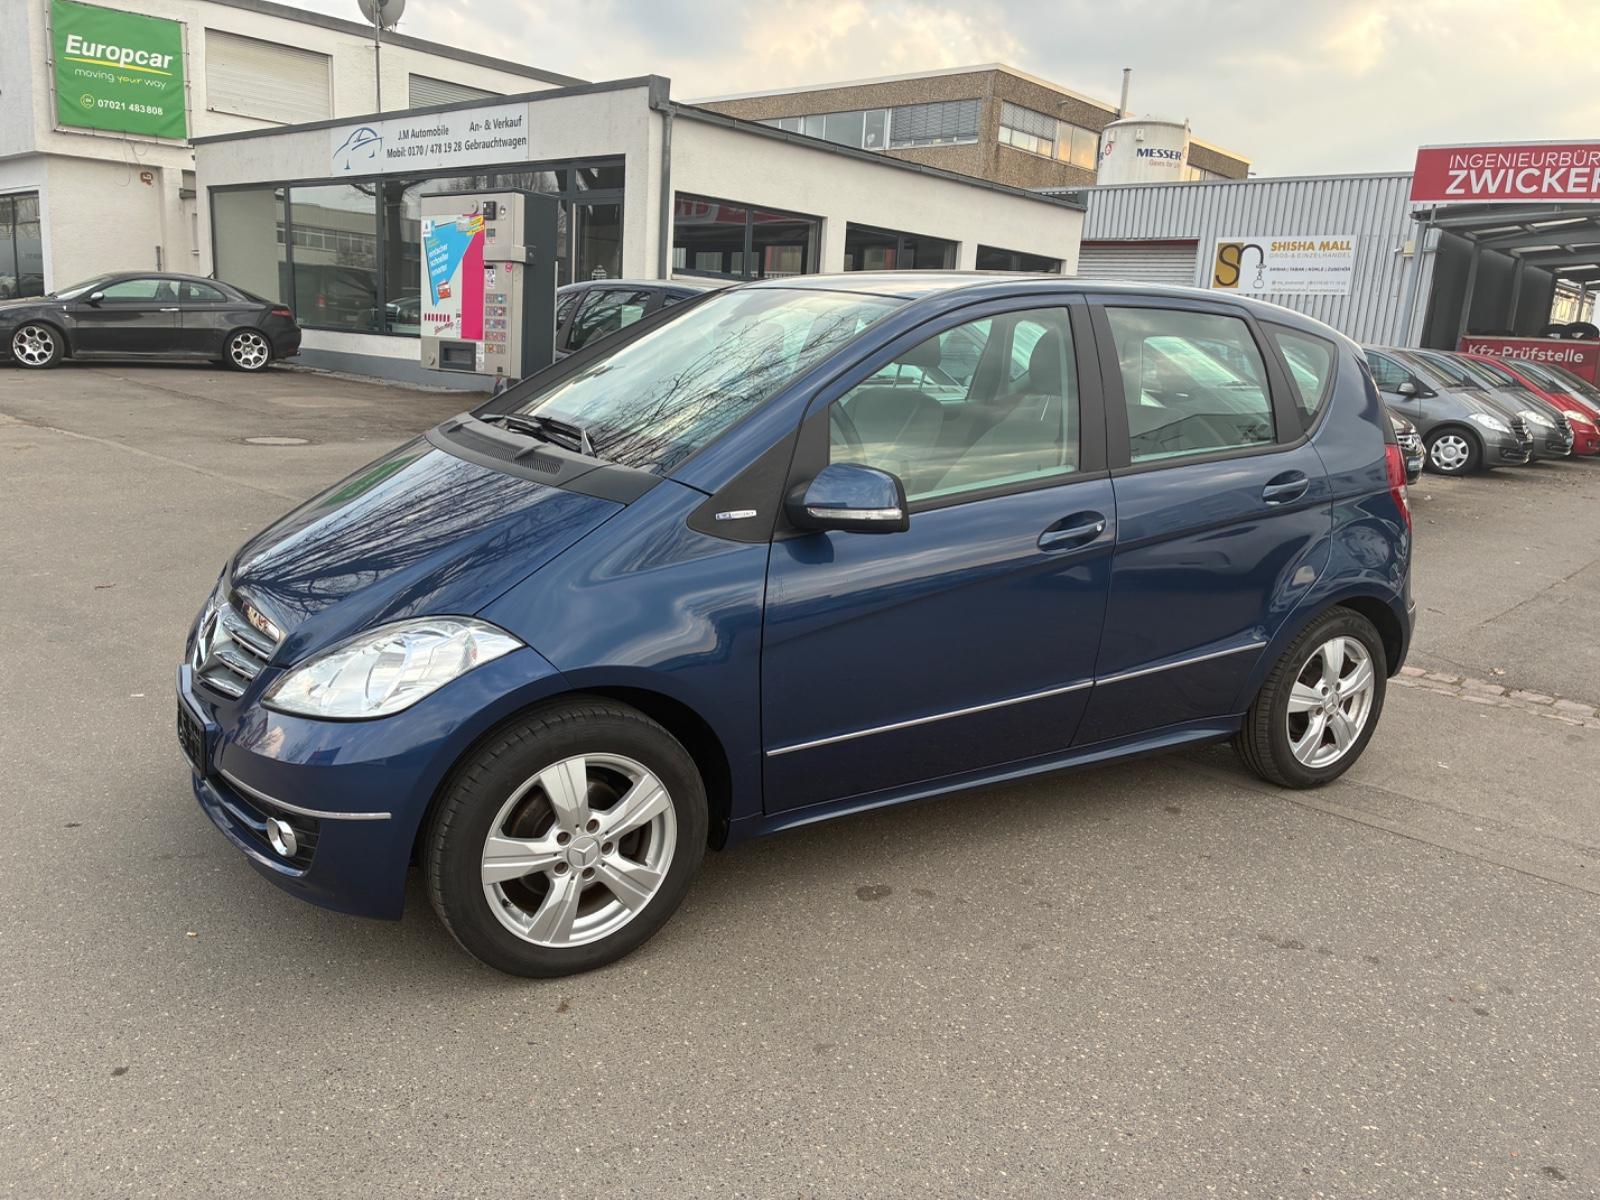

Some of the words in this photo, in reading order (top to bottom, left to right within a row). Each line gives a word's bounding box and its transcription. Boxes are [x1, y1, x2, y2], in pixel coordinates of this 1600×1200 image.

[65, 34, 173, 68] Europcar
[75, 69, 115, 82] moving
[117, 75, 142, 84] your
[144, 79, 167, 90] way
[97, 99, 126, 110] 07021
[469, 121, 482, 132] An-
[484, 119, 491, 130] &
[493, 115, 522, 129] Verkauf
[398, 129, 410, 140] J.M
[410, 124, 449, 139] Automobile
[408, 145, 424, 156] 0170
[425, 144, 429, 156] /
[430, 143, 442, 154] 478
[444, 142, 452, 153] 19
[454, 141, 462, 152] 28
[465, 136, 527, 150] Gebrauchtwagen
[1136, 148, 1182, 160] MESSER
[1271, 240, 1315, 252] SHISHA
[1319, 239, 1352, 251] MALL
[1467, 344, 1584, 363] Kfz-Prüfstelle
